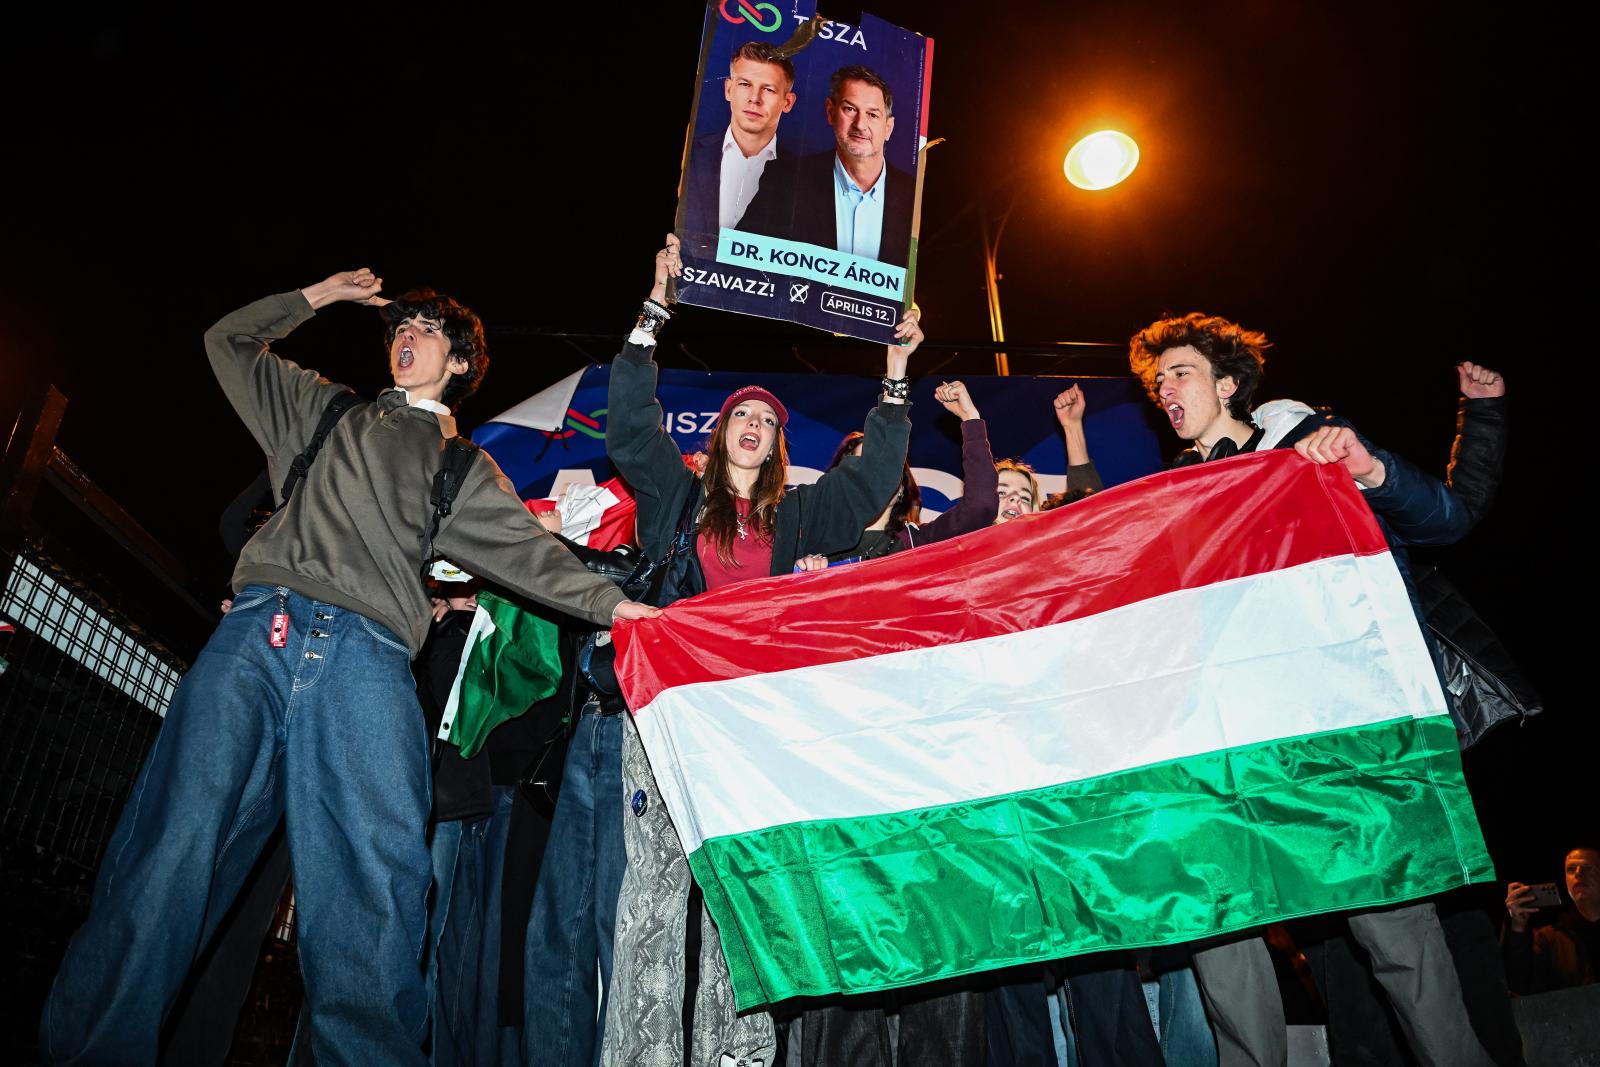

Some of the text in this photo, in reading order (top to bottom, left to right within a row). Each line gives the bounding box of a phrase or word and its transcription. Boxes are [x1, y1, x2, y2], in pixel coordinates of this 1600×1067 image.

[793, 15, 868, 51] TSZA
[730, 241, 900, 292] DR. KONCZ ÁRON
[682, 266, 776, 298] SZAVAZZ!
[826, 295, 890, 322] ÁPRILIS 12.
[666, 411, 721, 434] ISZ
[273, 618, 283, 642] Koak
